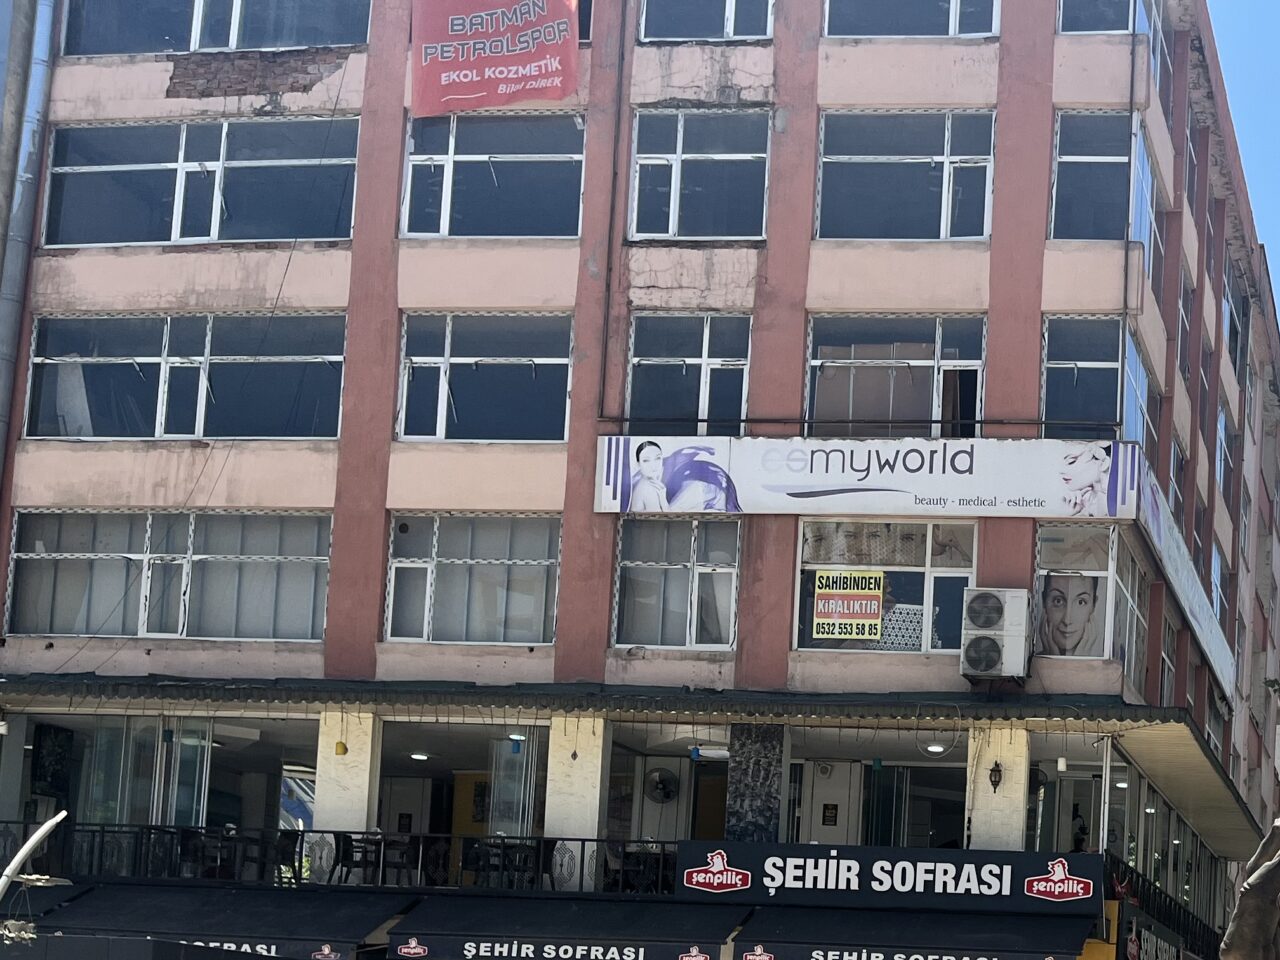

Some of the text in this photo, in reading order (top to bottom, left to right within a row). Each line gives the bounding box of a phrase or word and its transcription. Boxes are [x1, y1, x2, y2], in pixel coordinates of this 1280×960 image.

[449, 0, 547, 35] BATMAN
[422, 19, 571, 66] PETROLSPOR
[441, 55, 562, 85] EKOL KOZMETİK
[525, 76, 563, 89] DİREK
[914, 495, 949, 508] beauty
[958, 496, 997, 508] medical
[1006, 496, 1046, 508] esthetic
[817, 573, 882, 591] SAHİBİNDEN
[816, 622, 879, 636] 0532 553 58 85
[692, 871, 744, 889] şenpiliç
[762, 850, 1012, 896] ŞEHİR SOFRASI
[1032, 879, 1085, 897] şenpiliç
[463, 940, 645, 960] ŞEHİR SOFRASI
